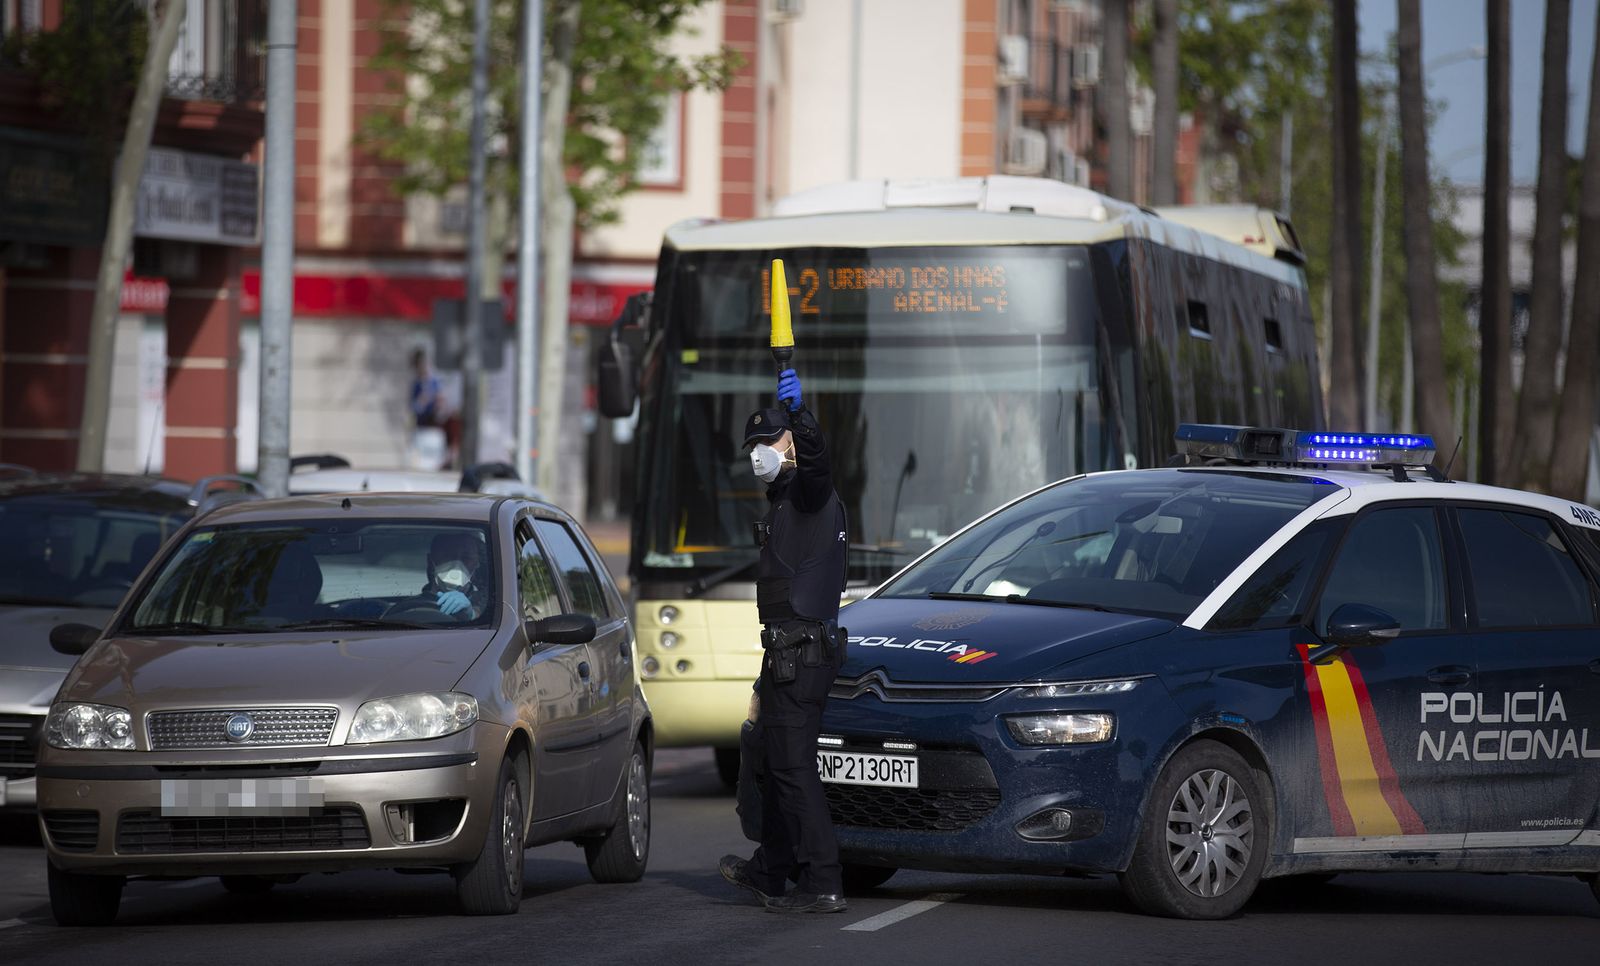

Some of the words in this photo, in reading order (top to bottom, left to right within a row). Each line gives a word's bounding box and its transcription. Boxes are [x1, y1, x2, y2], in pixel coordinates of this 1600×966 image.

[828, 266, 905, 290] URBANO
[911, 266, 950, 289] DOS
[953, 265, 1006, 288] HNAS
[1420, 684, 1567, 723] POLICÍA
[230, 722, 249, 731] FIAT
[1417, 728, 1600, 761] NACIONAL
[1520, 816, 1585, 829] www.policia.es
